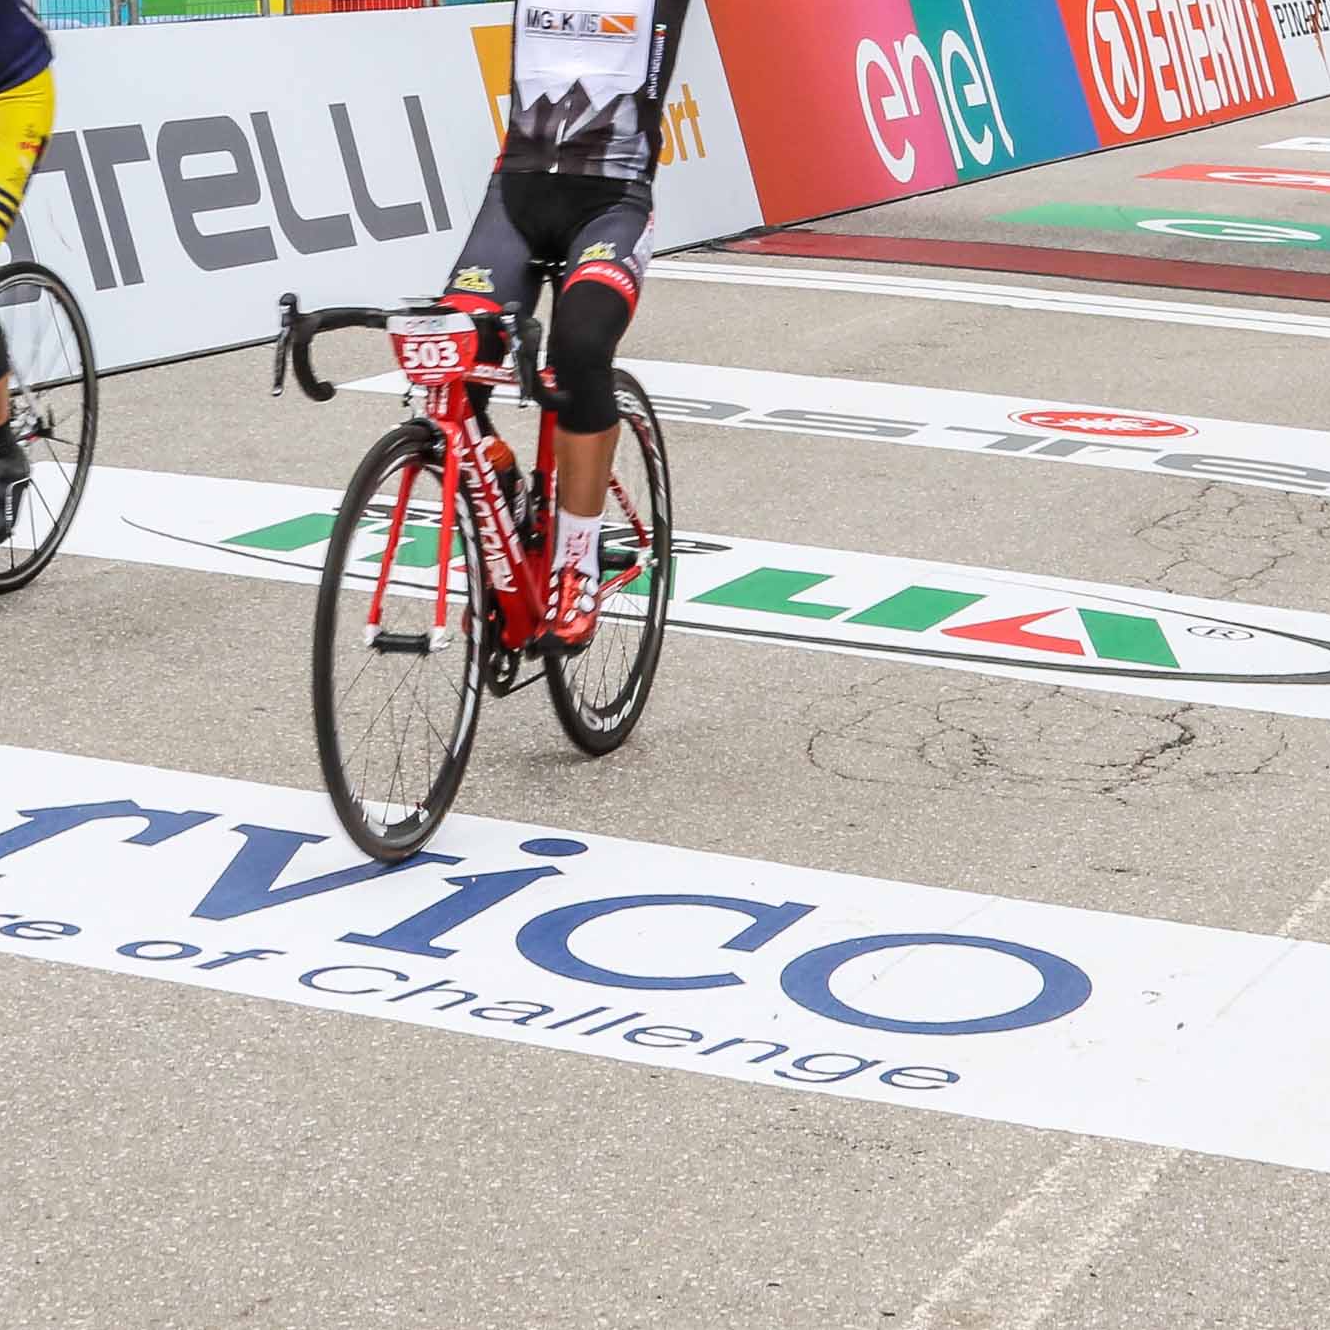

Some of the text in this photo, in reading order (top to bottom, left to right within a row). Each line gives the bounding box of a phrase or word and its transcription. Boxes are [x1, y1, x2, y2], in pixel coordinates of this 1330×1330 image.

[658, 83, 707, 166] ort
[402, 340, 459, 368] 503
[115, 939, 287, 970] of
[299, 962, 961, 1092] Challenge
